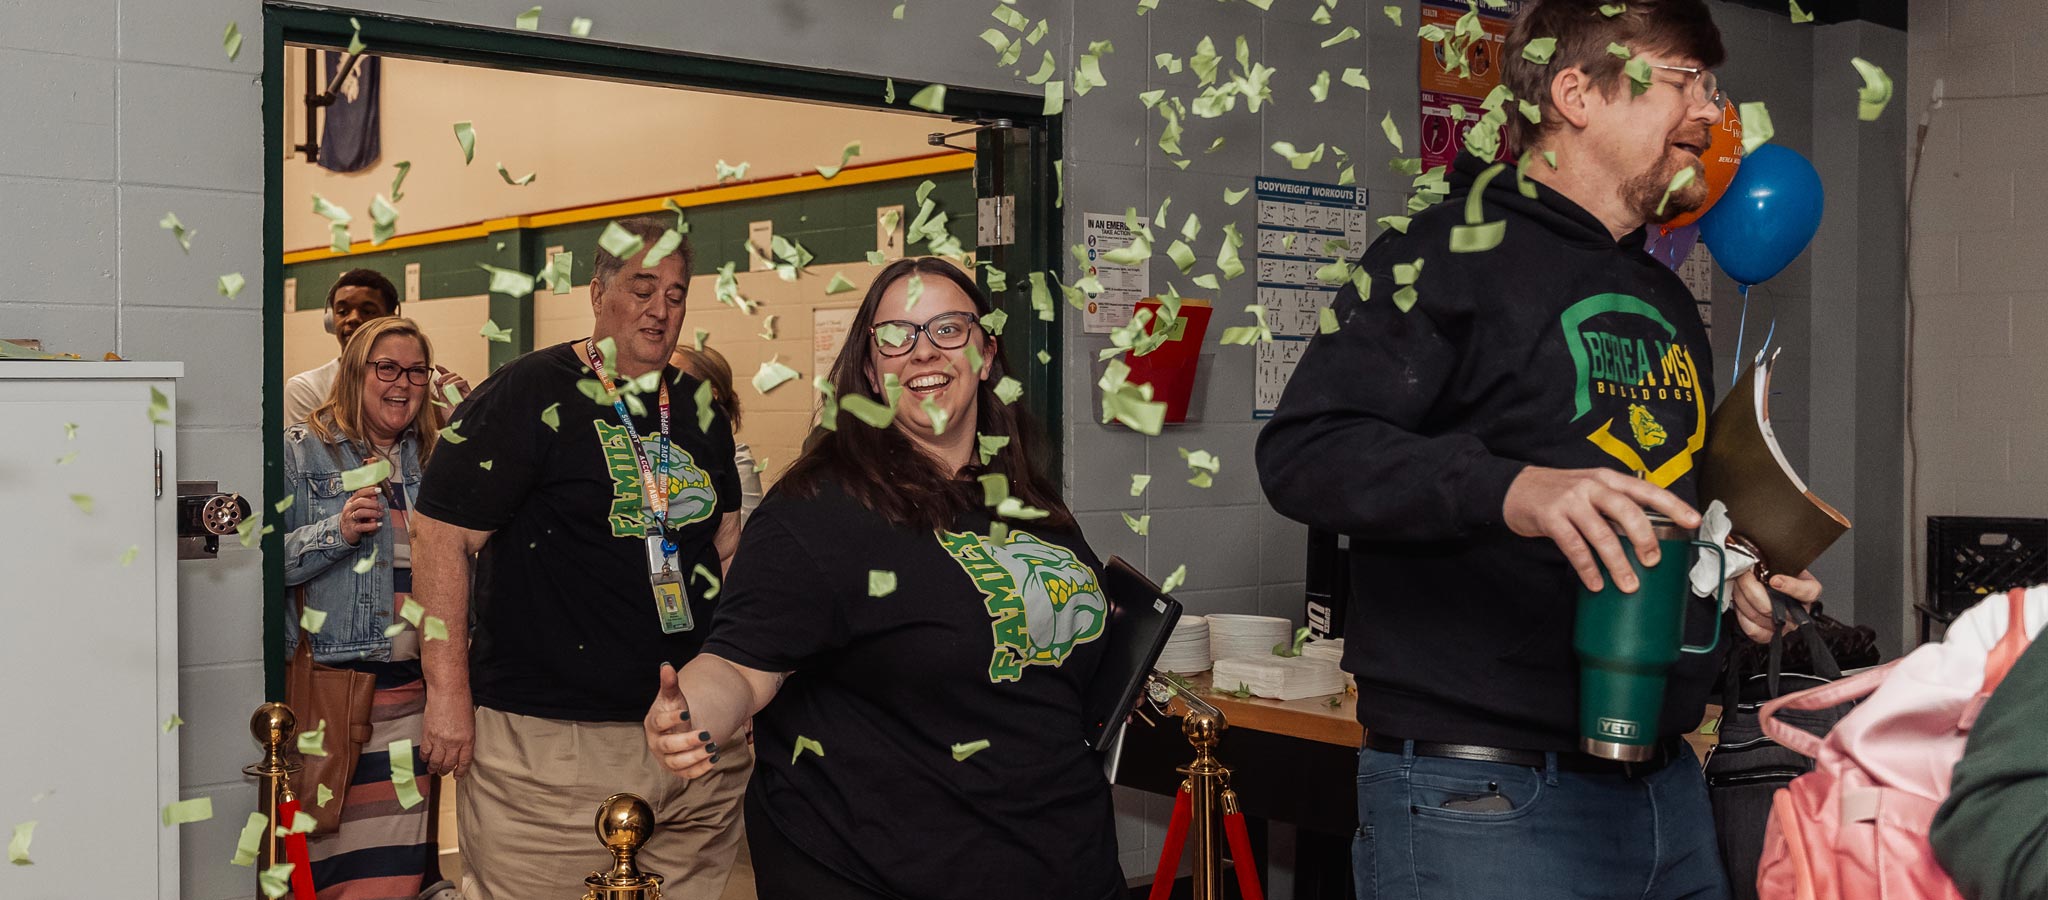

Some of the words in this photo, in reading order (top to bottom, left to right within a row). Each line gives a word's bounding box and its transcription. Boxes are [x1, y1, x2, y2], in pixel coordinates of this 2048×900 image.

[1257, 181, 1310, 195] BODYWEIGHT
[1312, 187, 1354, 200] WORKOUTS
[1358, 193, 1364, 203] 2
[1088, 219, 1094, 228] IN
[1095, 220, 1105, 229] AN
[1106, 221, 1145, 231] EMERY
[888, 236, 894, 248] 4
[1582, 331, 1657, 386] BEREA
[1655, 340, 1692, 388] MS
[1597, 381, 1692, 402] BULLDOGS
[661, 406, 669, 435] SUPPORT
[661, 444, 669, 463] LOVE
[621, 414, 641, 444] SUPPORT
[639, 455, 665, 519] ACCOUNTABILITY
[593, 418, 646, 539] FAMILY
[934, 529, 1031, 683] FAMILY
[1601, 721, 1636, 736] YETI
